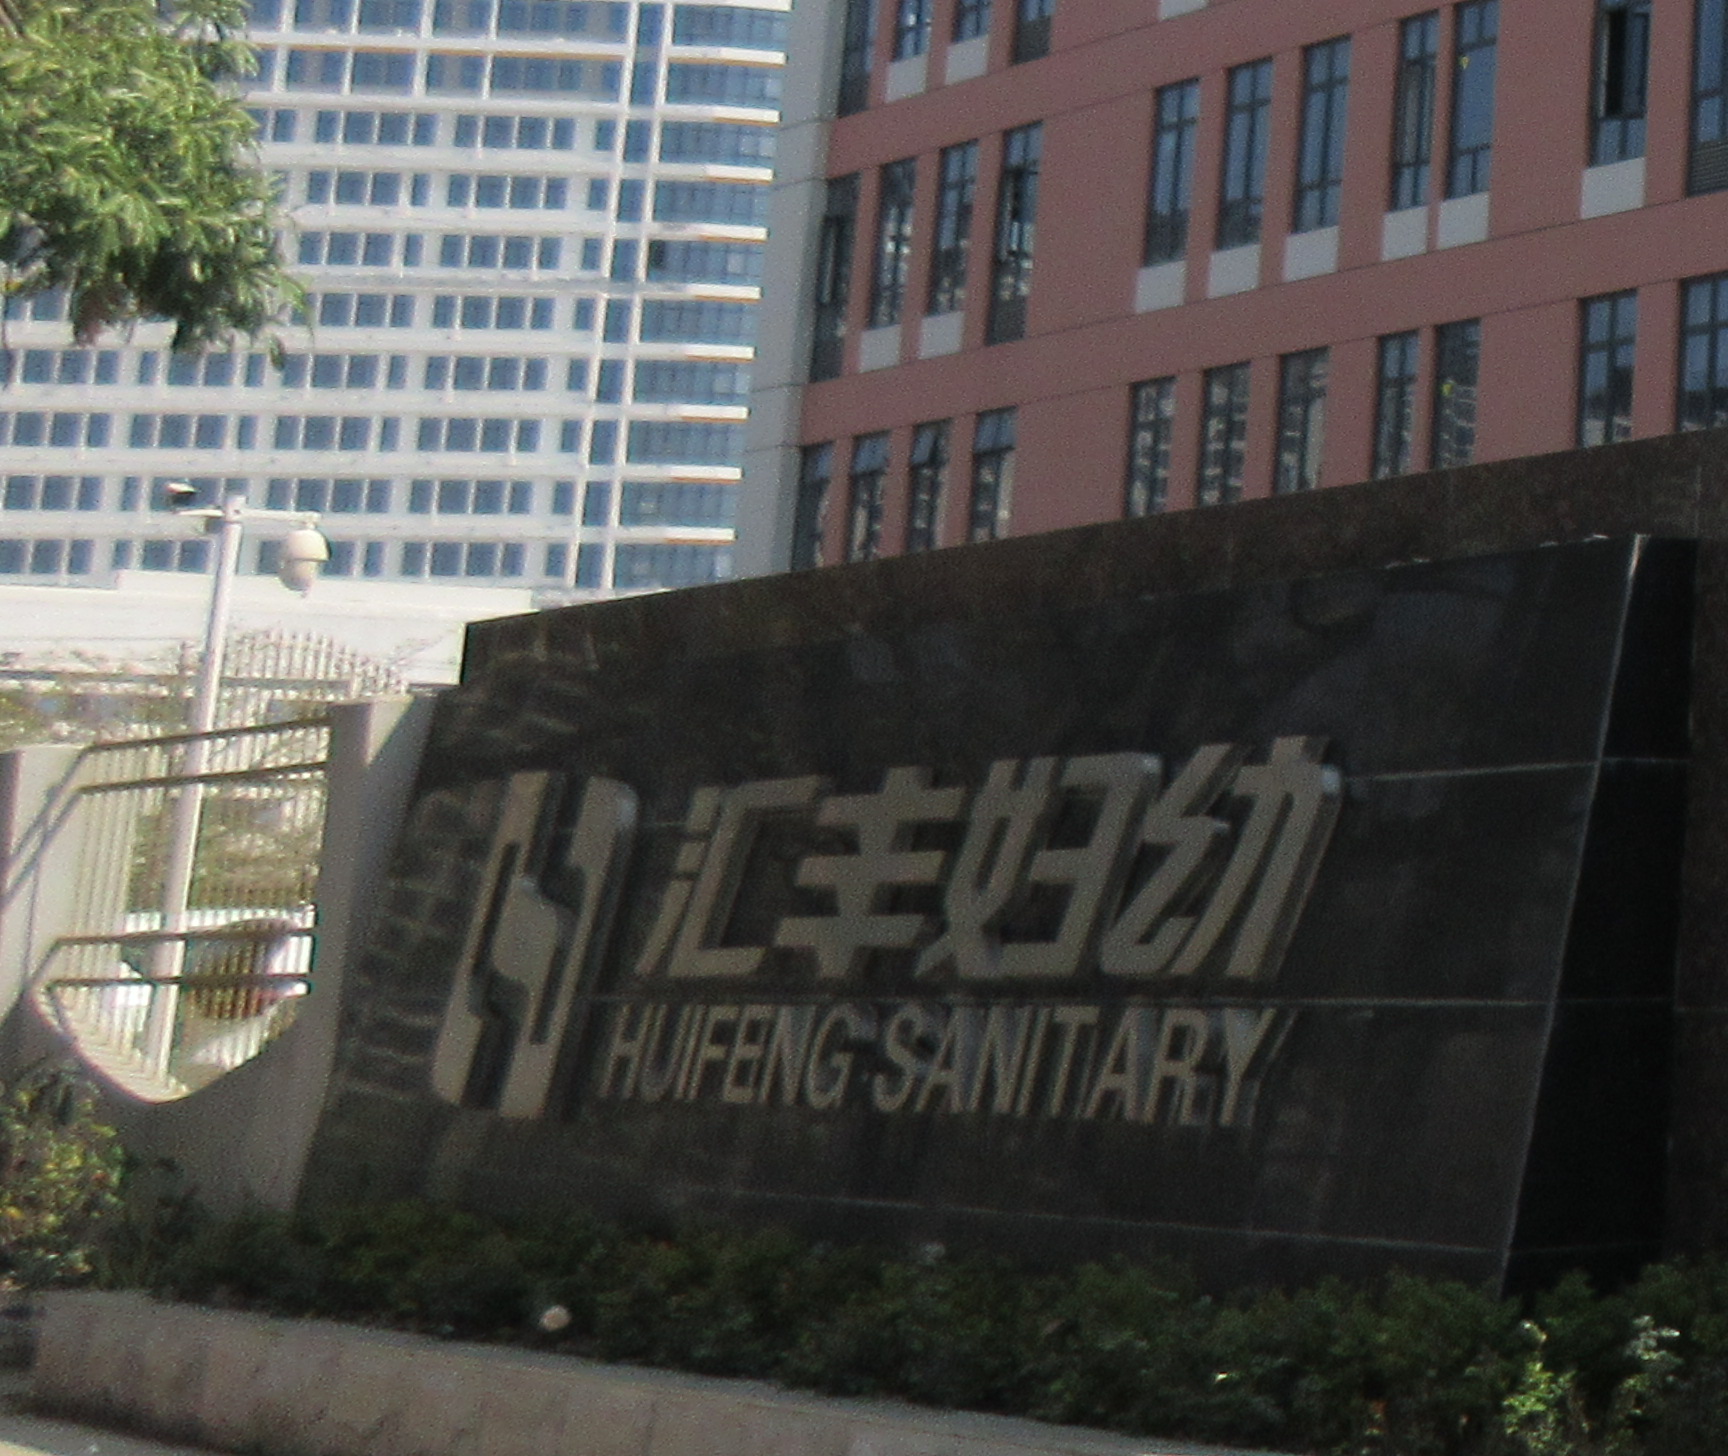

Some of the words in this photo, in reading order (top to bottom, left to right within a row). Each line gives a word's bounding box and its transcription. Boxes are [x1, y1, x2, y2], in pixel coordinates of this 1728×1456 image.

[634, 736, 1335, 978] 汇丰妇幼
[600, 1003, 862, 1112] HUIFENG
[873, 1003, 1278, 1128] SANITARY
